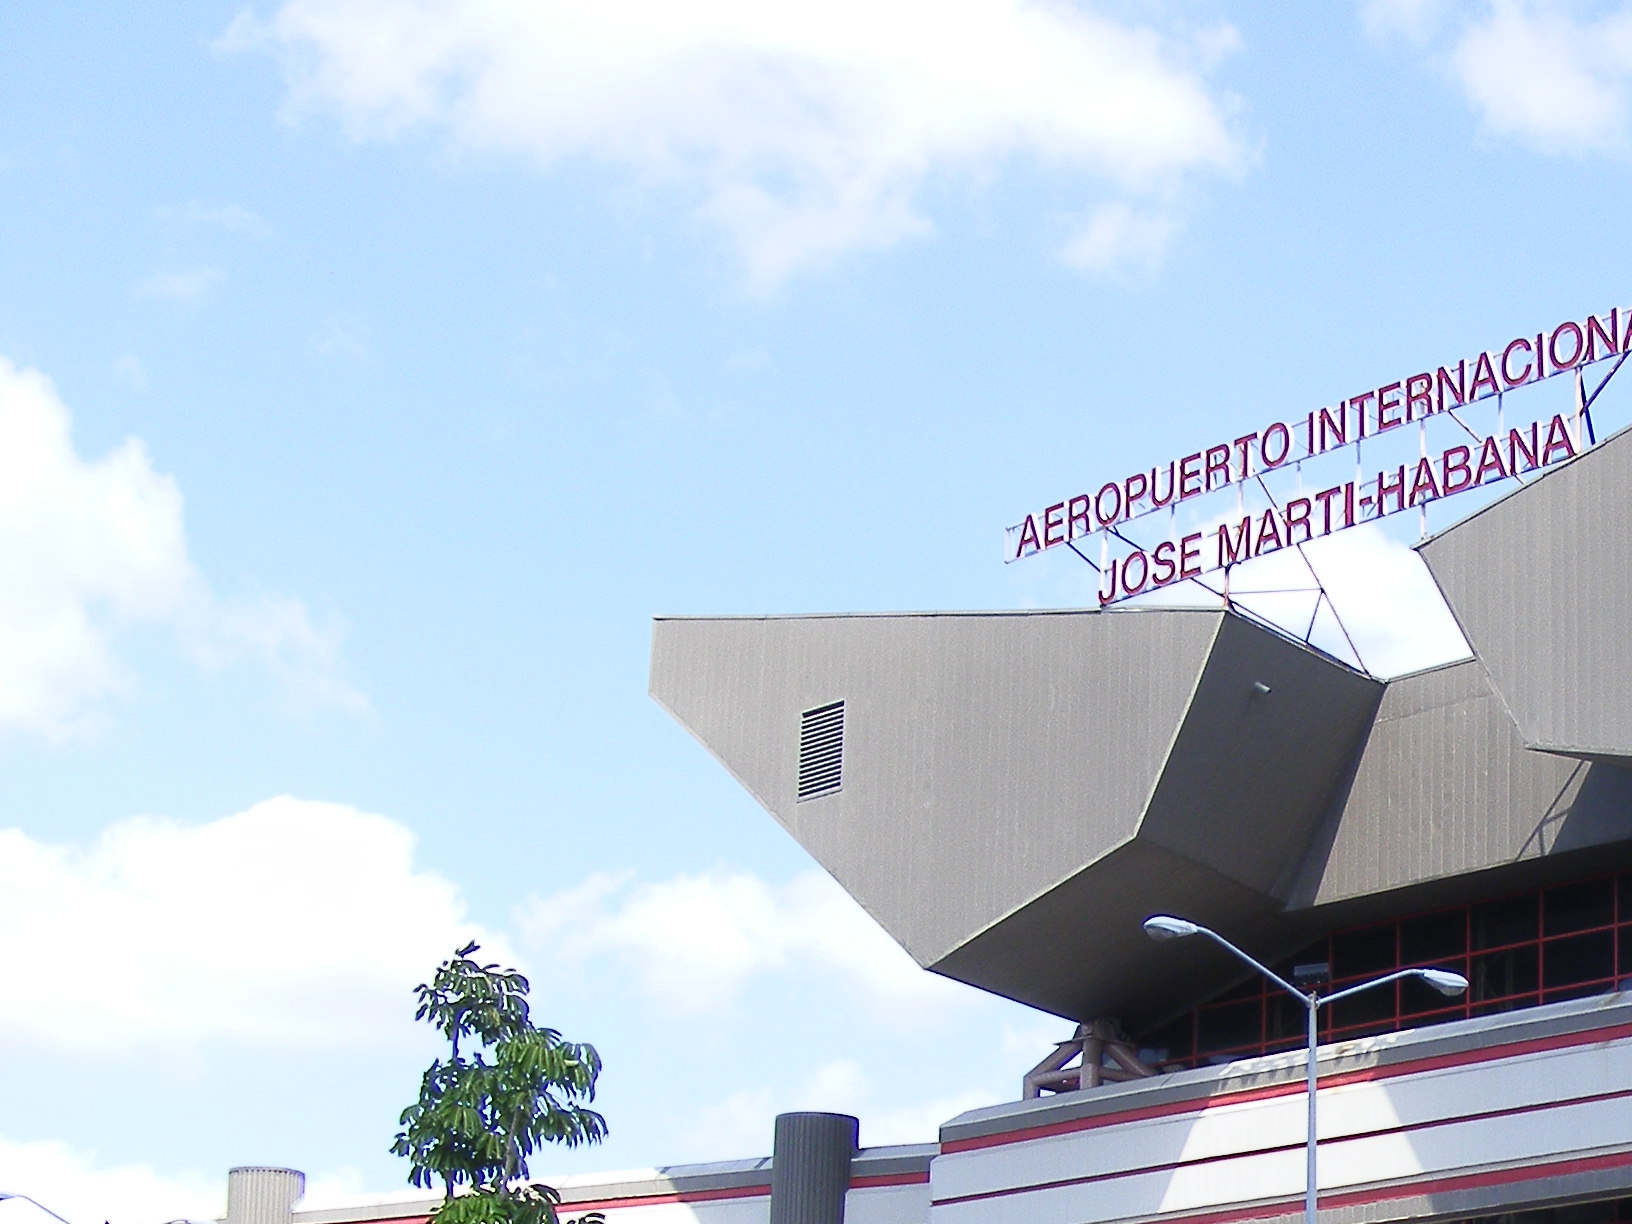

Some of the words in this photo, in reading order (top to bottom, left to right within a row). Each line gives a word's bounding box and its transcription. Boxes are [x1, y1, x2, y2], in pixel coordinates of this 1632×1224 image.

[1015, 421, 1292, 558] AEROPUERTO
[1098, 531, 1203, 605] JOSE
[1217, 412, 1578, 568] MARTI-HABANA
